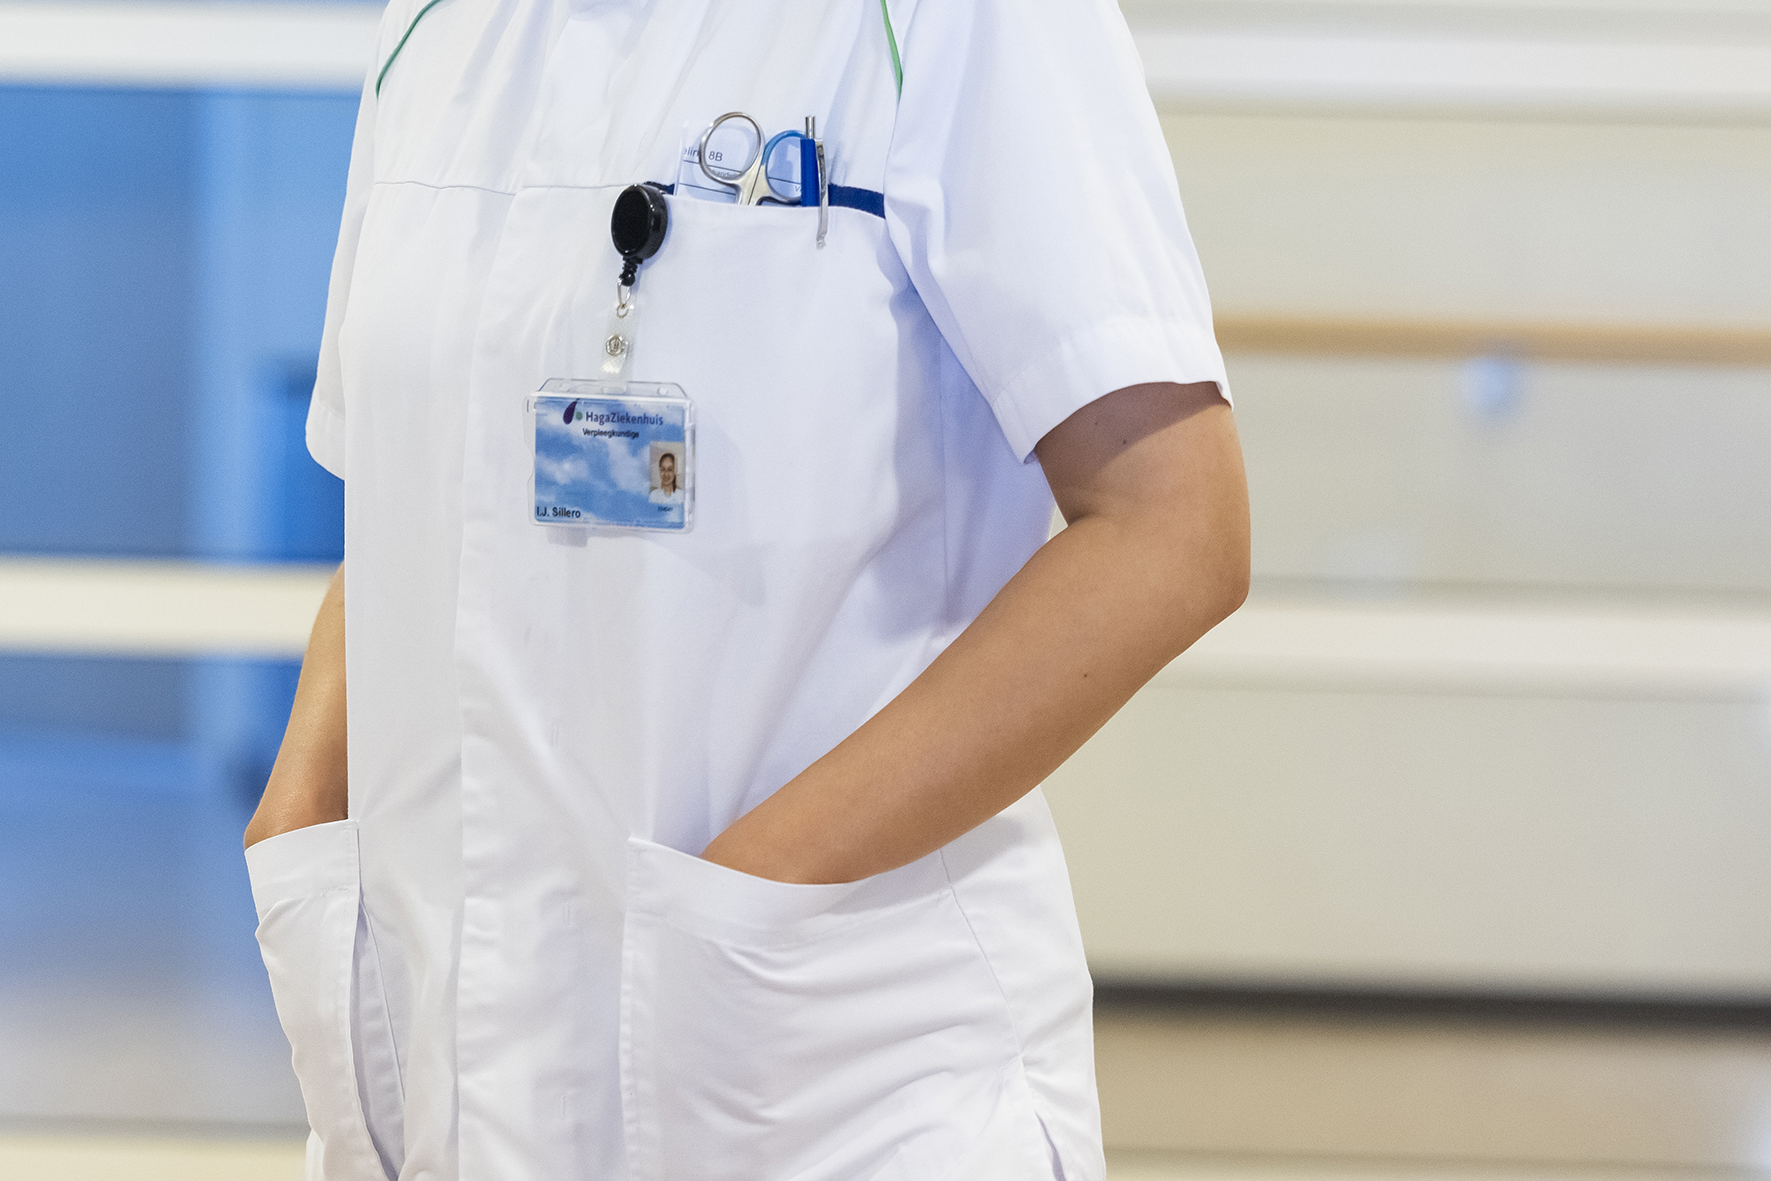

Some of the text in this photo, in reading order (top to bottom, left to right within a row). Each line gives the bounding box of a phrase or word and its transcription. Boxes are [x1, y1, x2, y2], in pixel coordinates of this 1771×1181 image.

[708, 150, 723, 162] 8B
[585, 411, 664, 426] HagaZiekenhuis
[552, 506, 581, 519] Sillero
